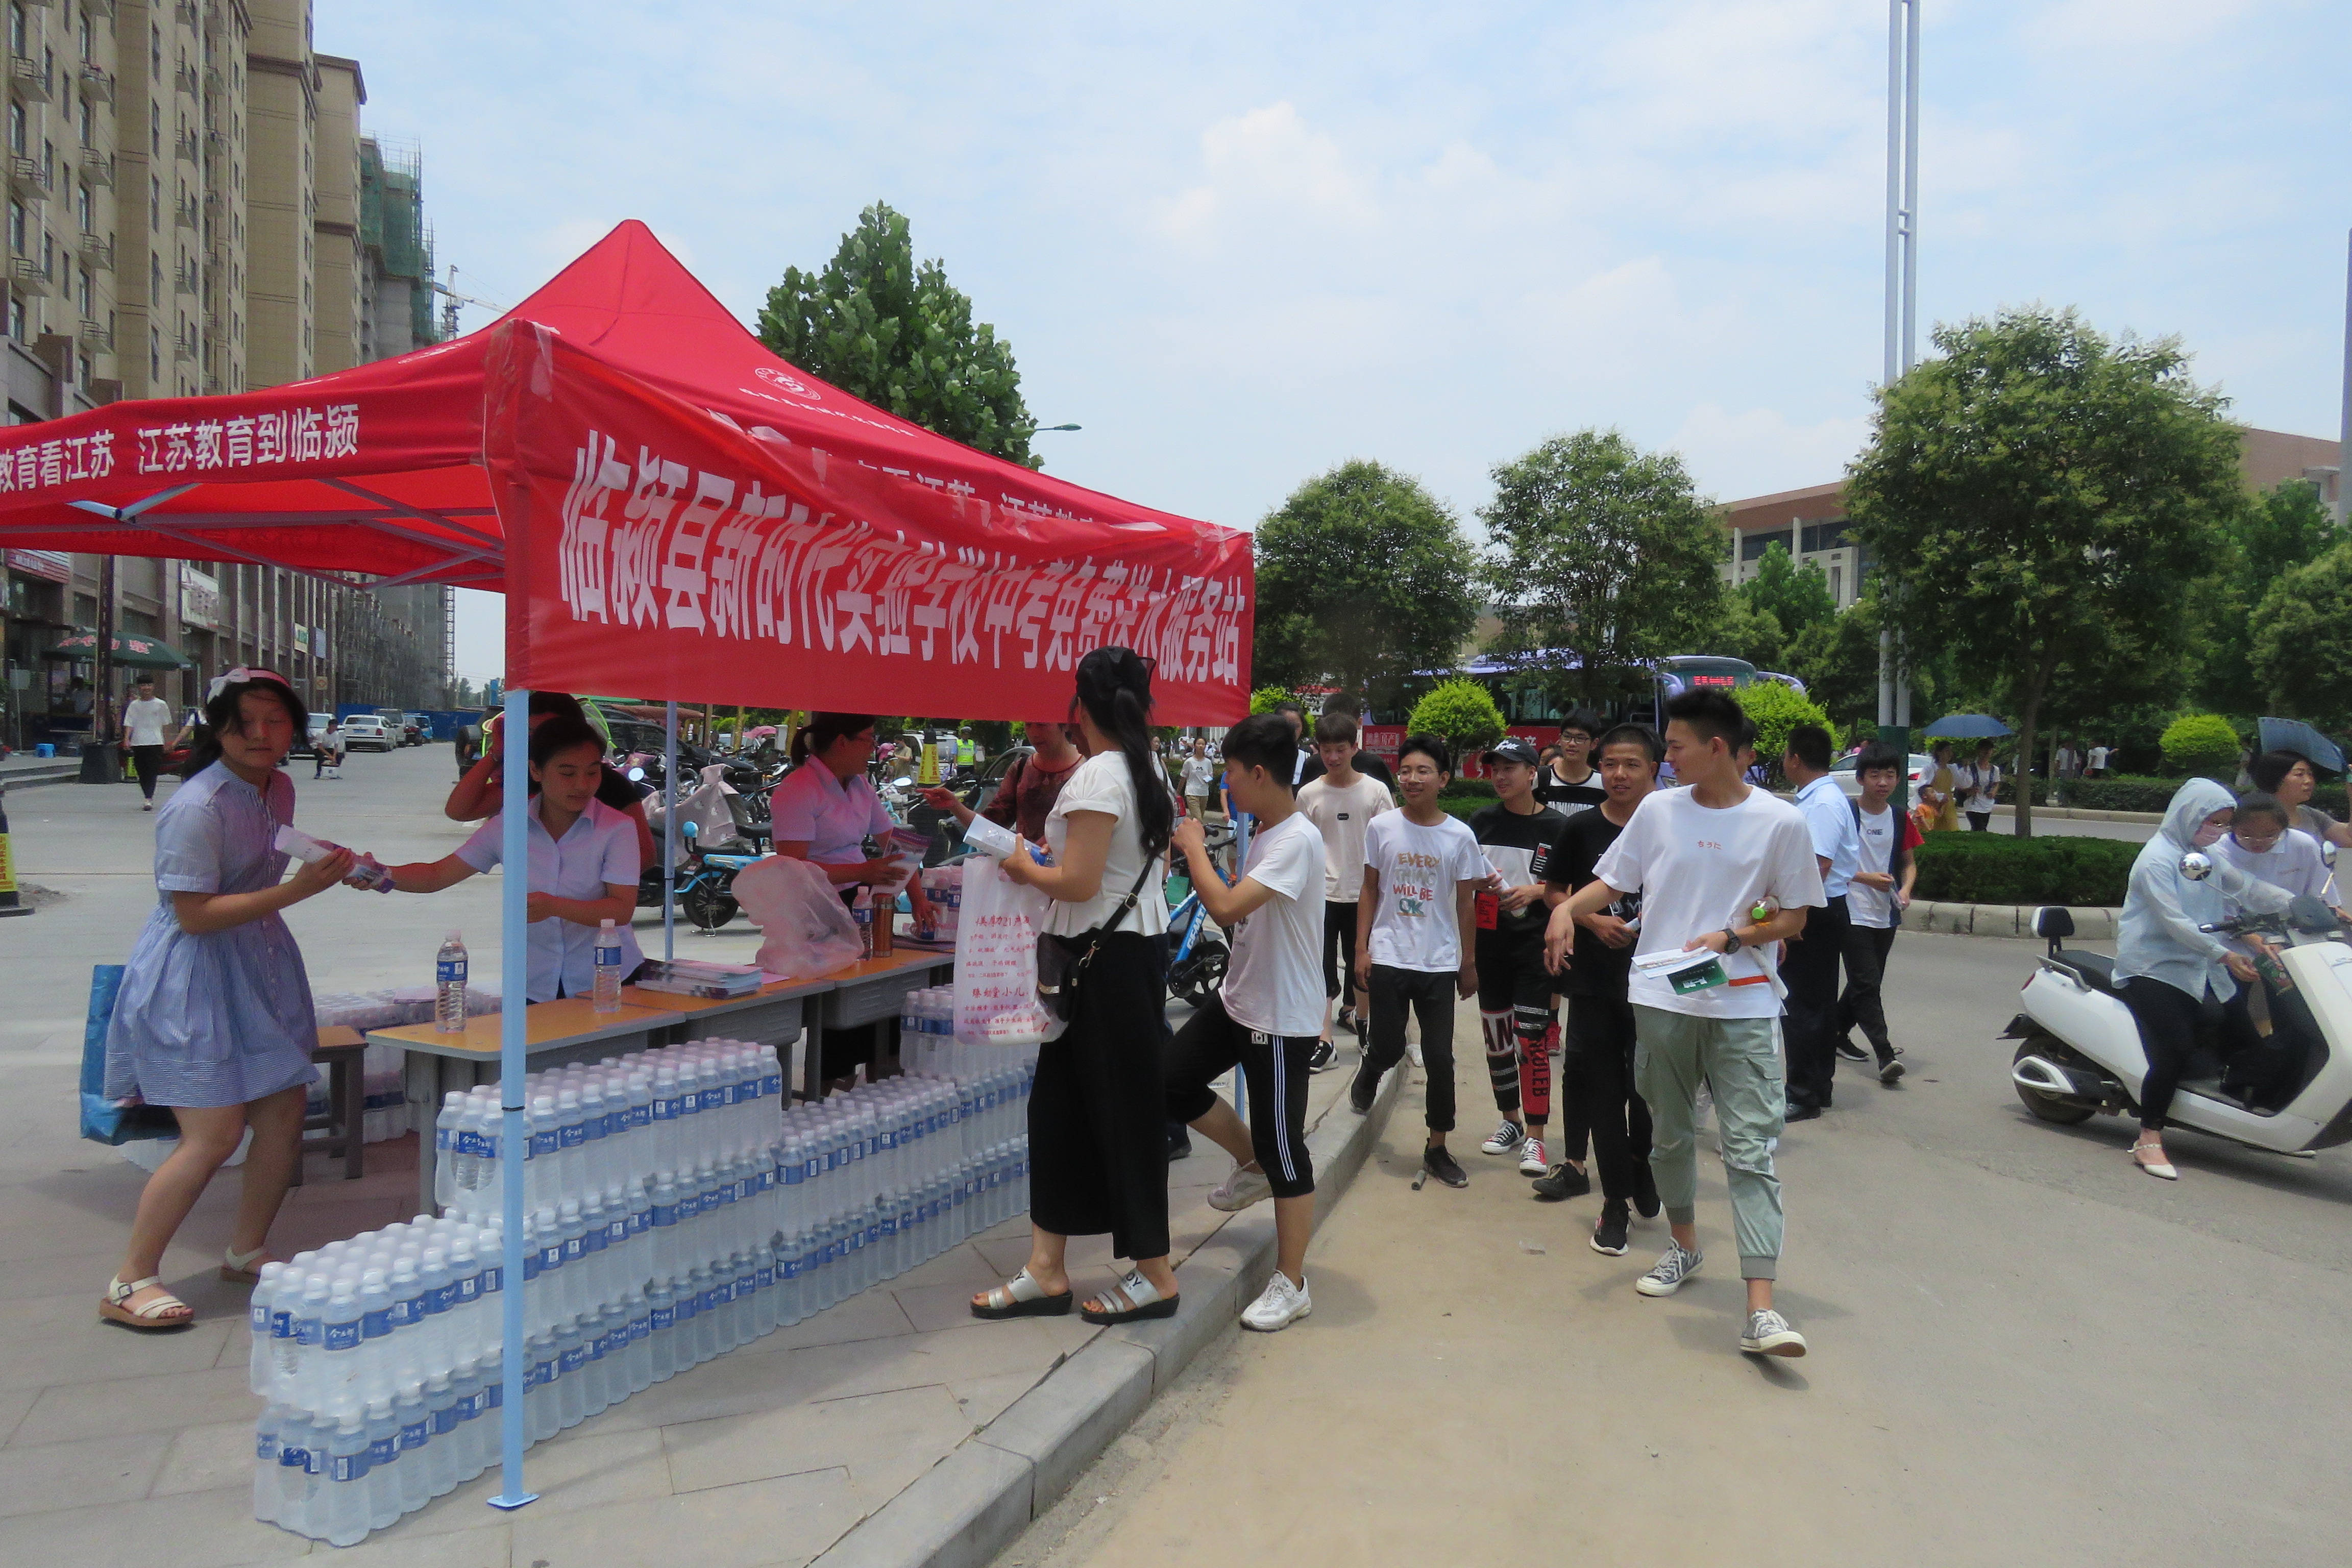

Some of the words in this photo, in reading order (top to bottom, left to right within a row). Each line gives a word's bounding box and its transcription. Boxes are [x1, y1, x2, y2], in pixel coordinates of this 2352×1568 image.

[1398, 852, 1440, 868] EVERY
[1392, 884, 1418, 896] WILL
[1419, 887, 1433, 901] BE
[1399, 898, 1424, 916] OK
